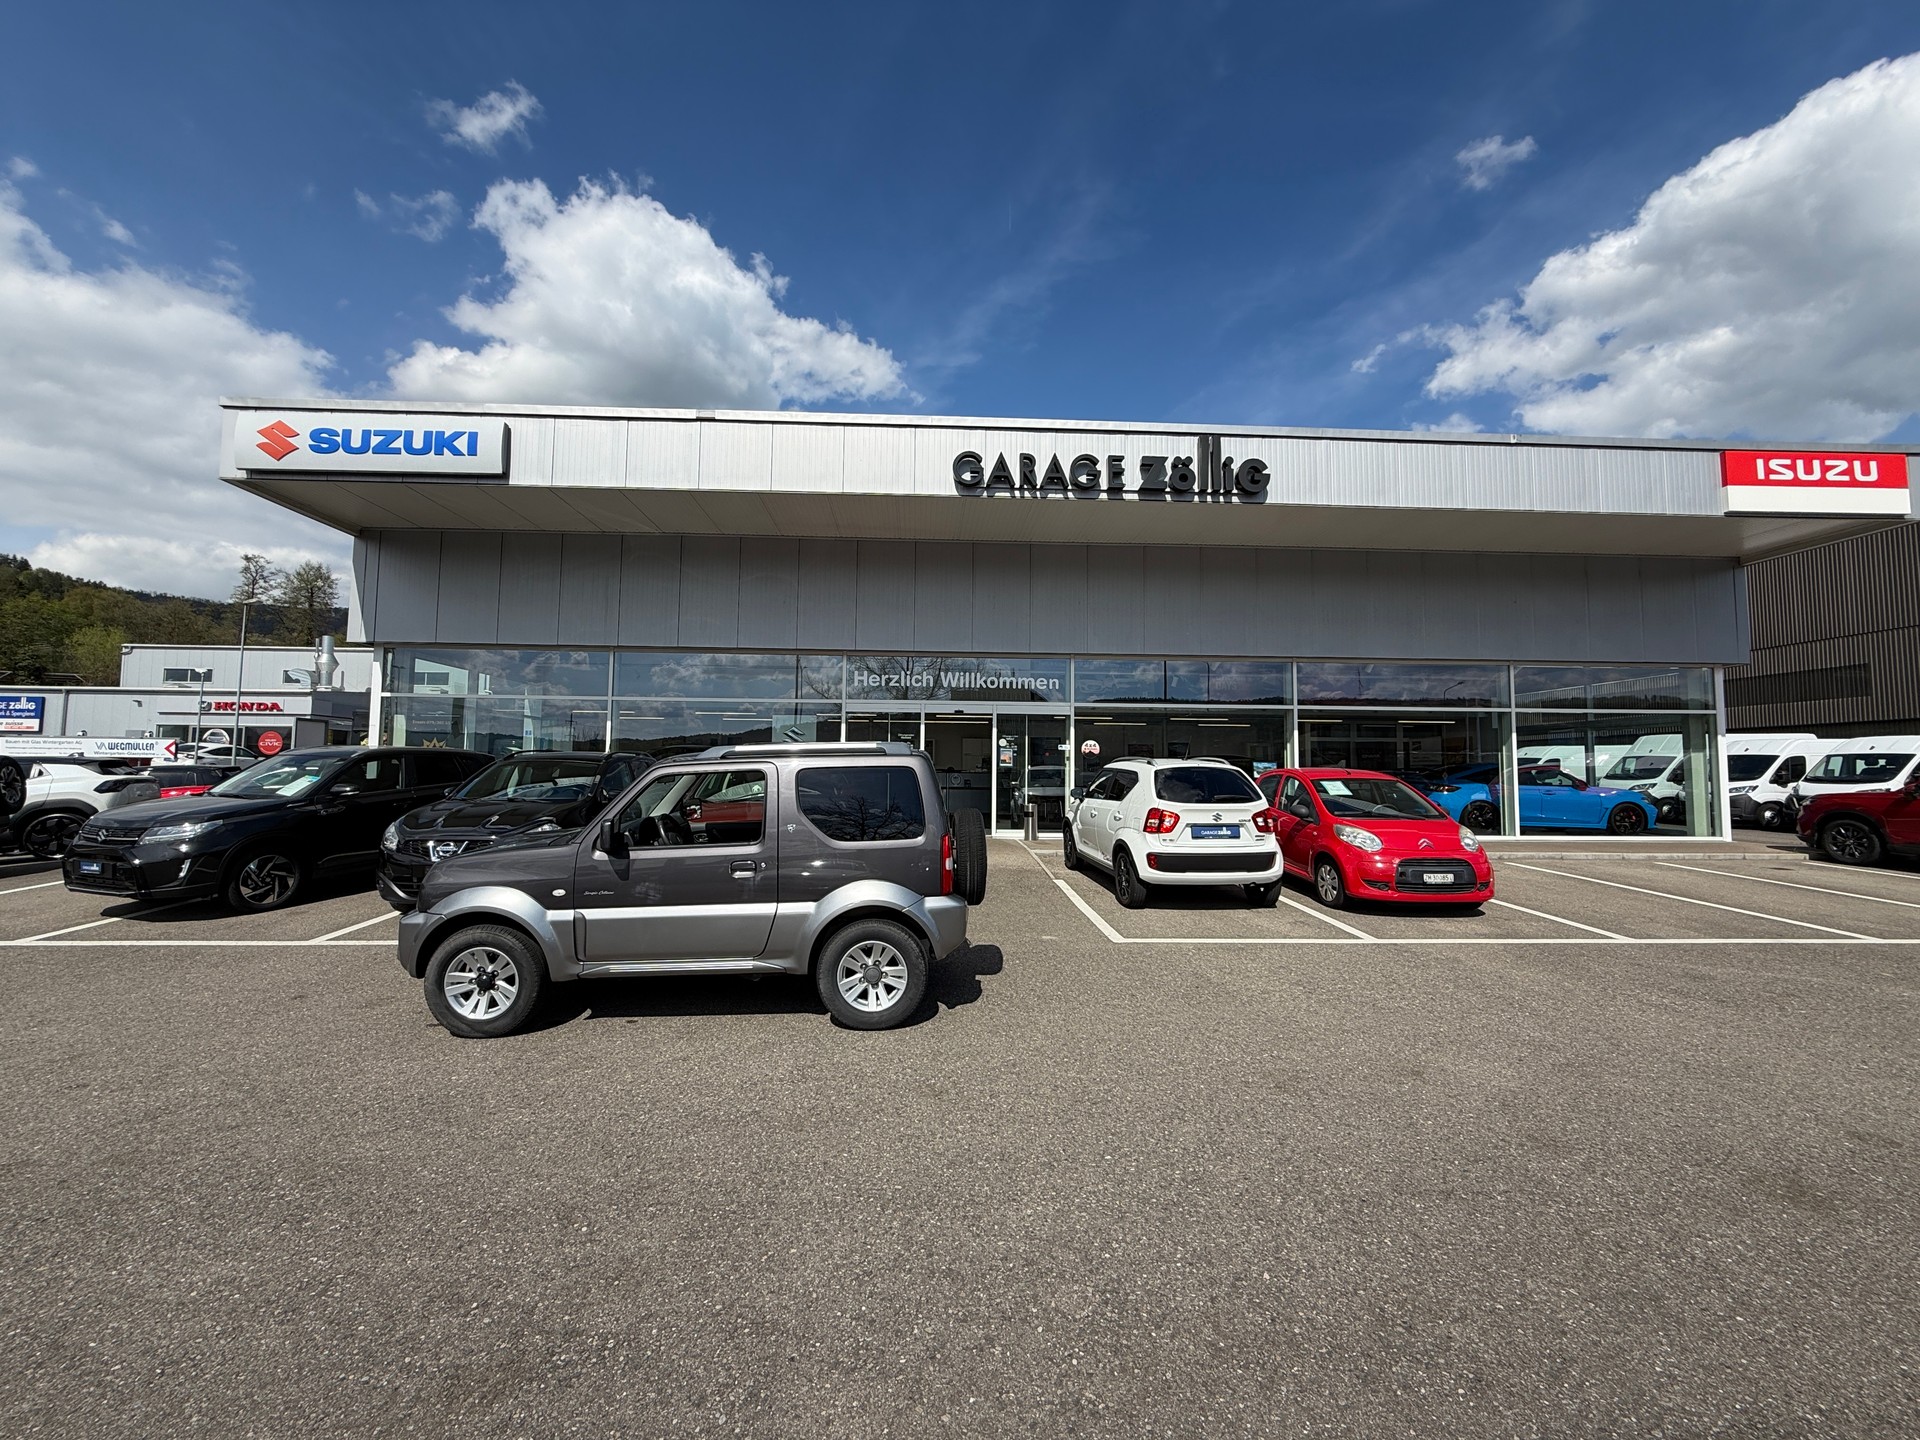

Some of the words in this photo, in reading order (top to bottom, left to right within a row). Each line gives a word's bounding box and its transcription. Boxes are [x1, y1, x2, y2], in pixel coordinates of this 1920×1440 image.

[308, 427, 478, 456] SUZUKI
[953, 450, 1126, 489] GARAGE
[1756, 458, 1879, 482] ISUZU
[853, 670, 934, 688] Herzlich
[940, 671, 1060, 690] Willkommen
[213, 702, 284, 712] HONDA
